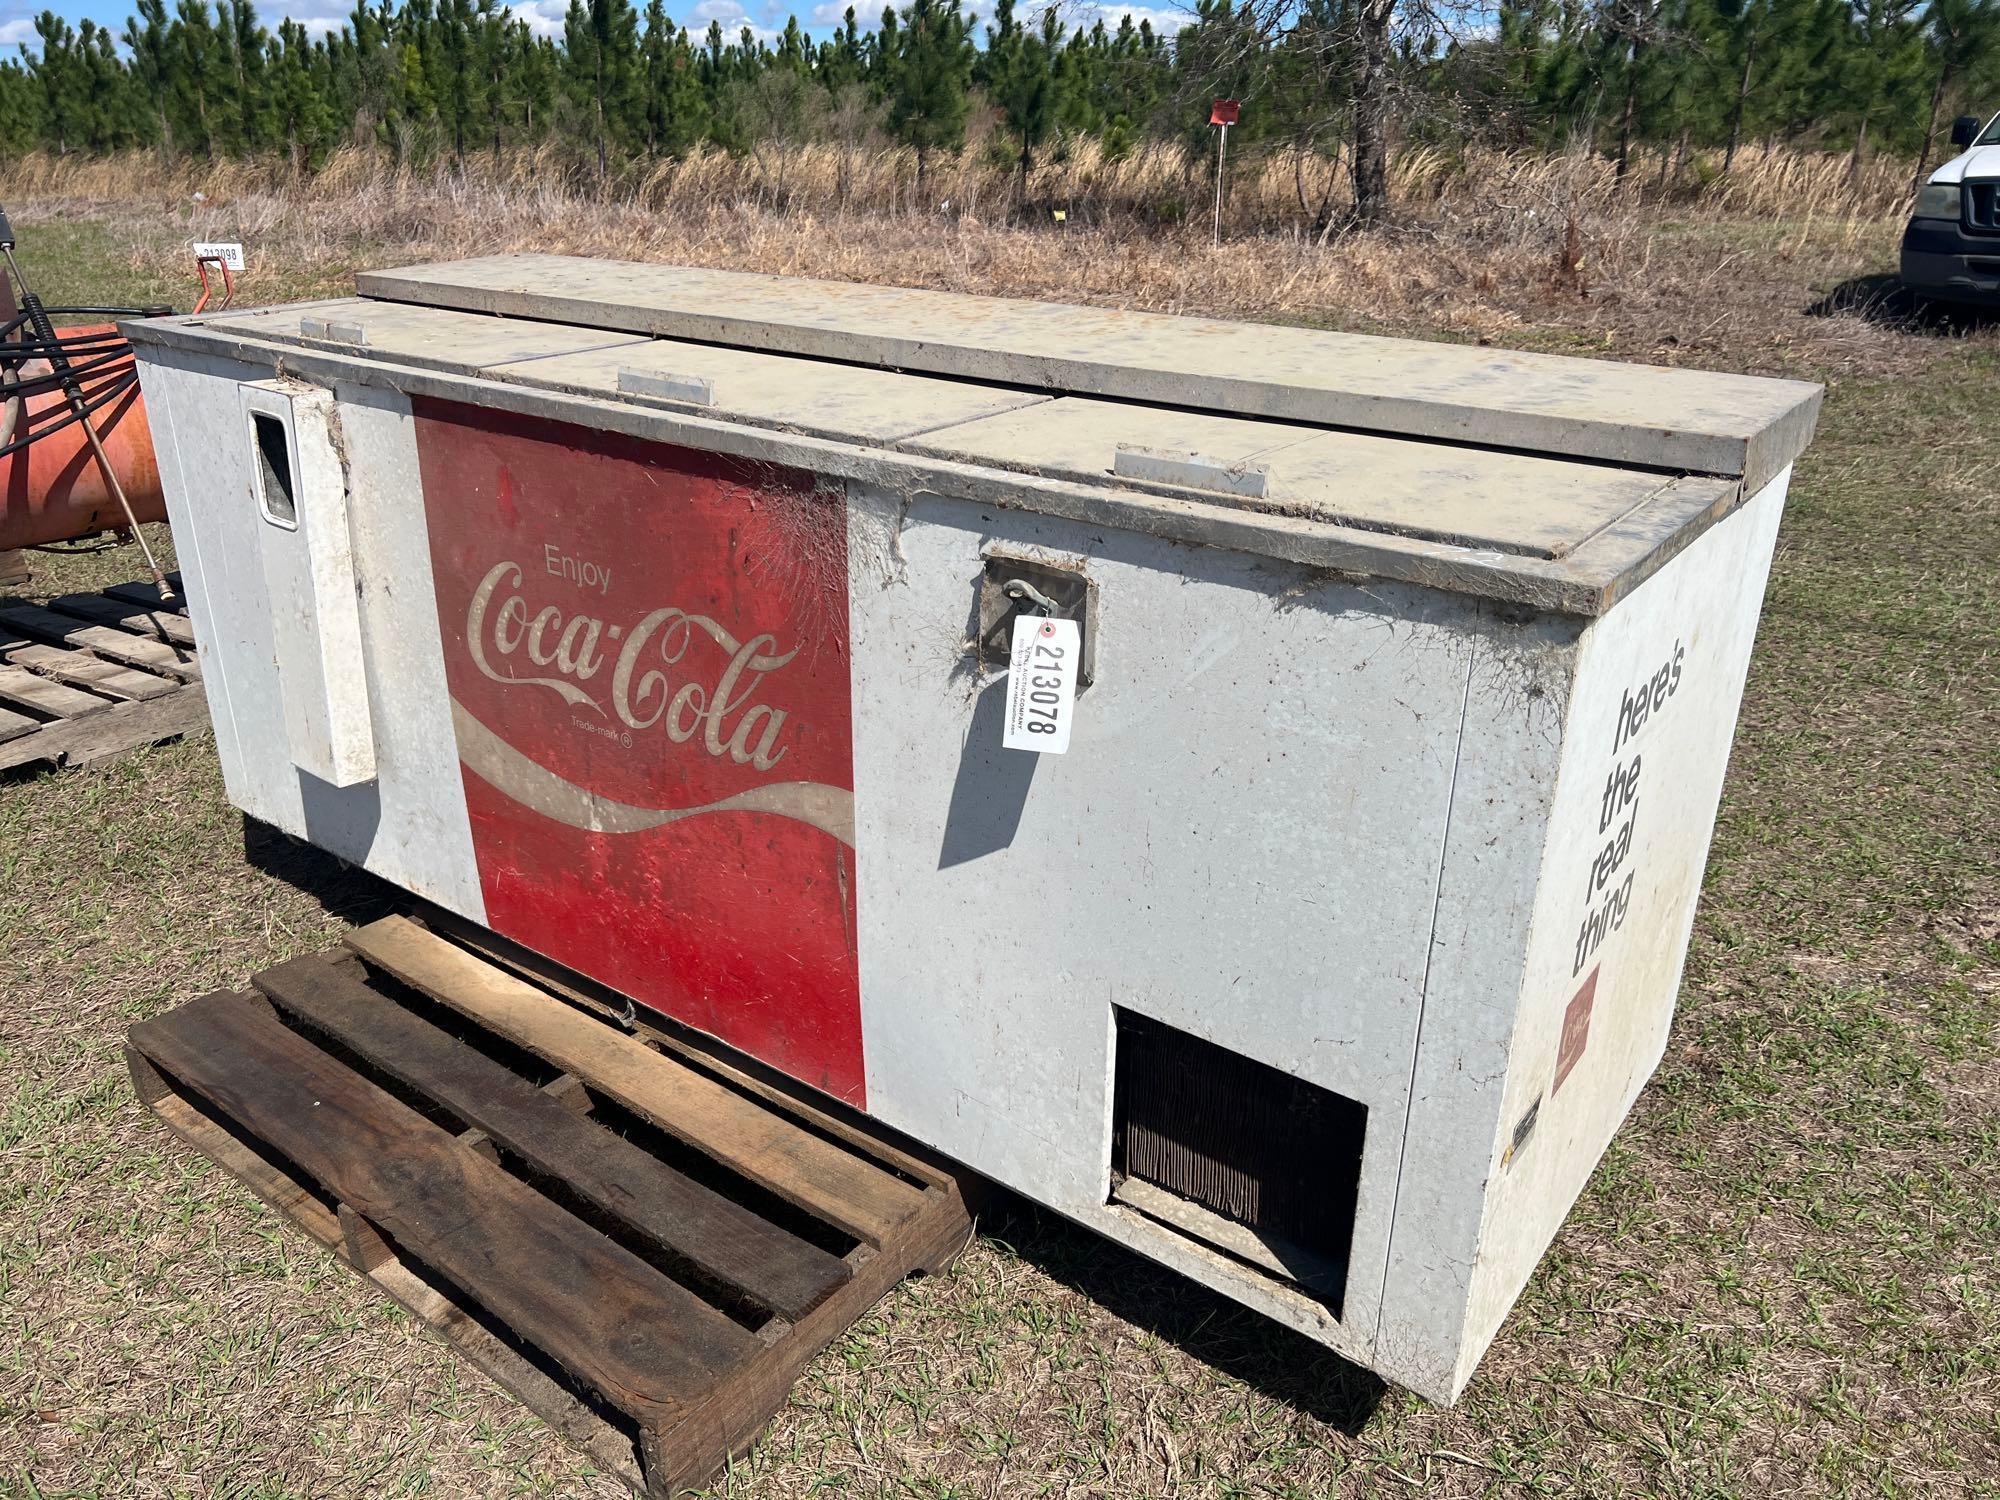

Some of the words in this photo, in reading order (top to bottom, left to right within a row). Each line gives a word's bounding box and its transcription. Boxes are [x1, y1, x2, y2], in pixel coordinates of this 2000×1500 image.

[203, 248, 237, 260] 213098
[544, 544, 611, 594] Enjoy
[467, 561, 803, 771] Coca-Cola
[1019, 668, 1029, 697] AUCTION
[1027, 645, 1065, 735] 213078
[1612, 638, 1685, 756] here's
[571, 715, 619, 742] Trade-mark
[1016, 698, 1026, 730] COMPANY
[1598, 754, 1642, 836] the
[1586, 797, 1640, 906] real
[1572, 868, 1635, 979] thing
